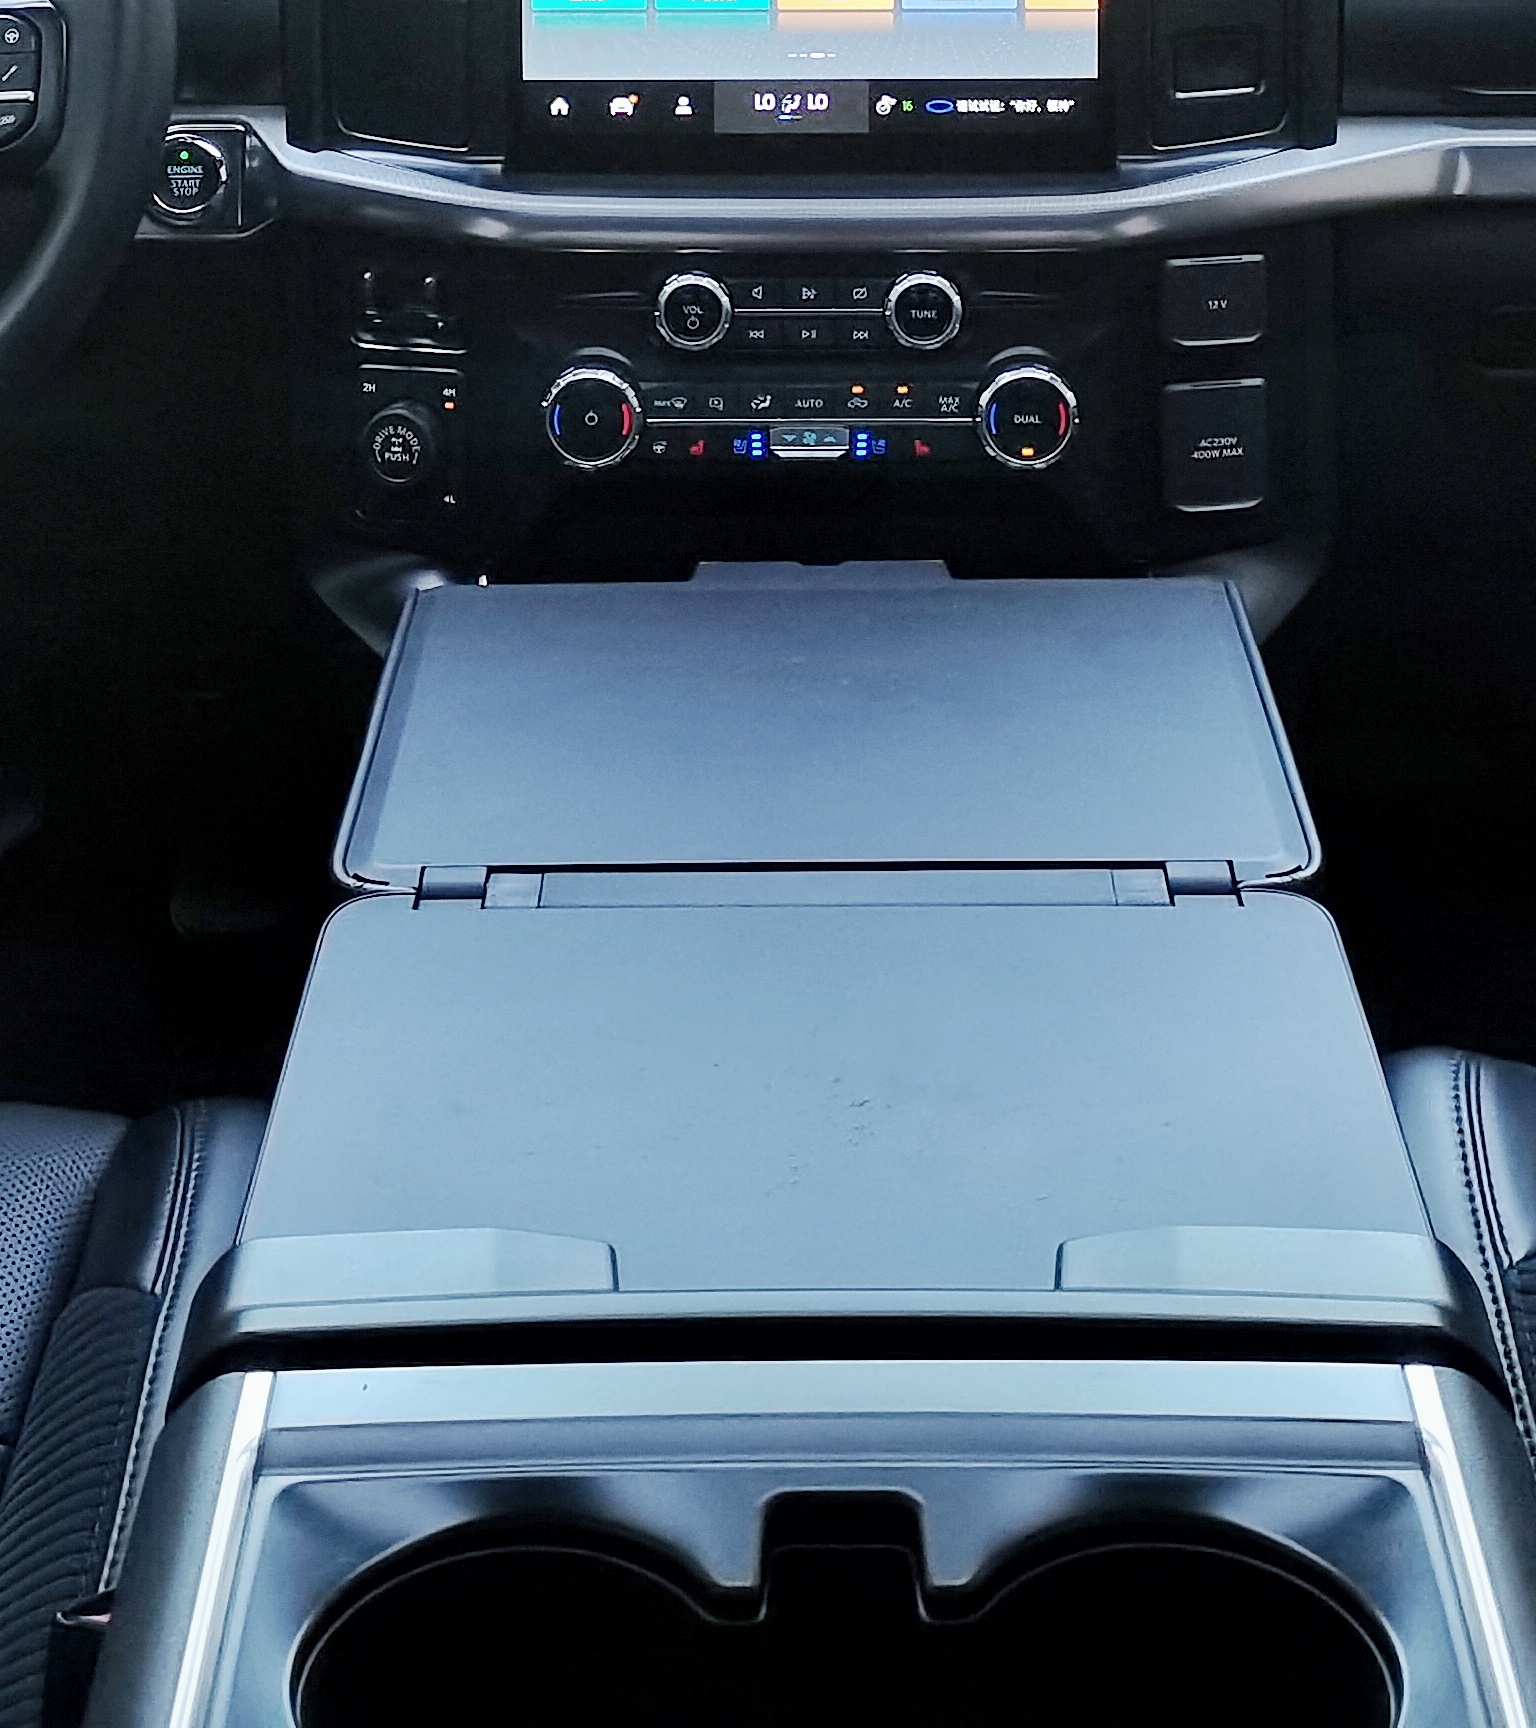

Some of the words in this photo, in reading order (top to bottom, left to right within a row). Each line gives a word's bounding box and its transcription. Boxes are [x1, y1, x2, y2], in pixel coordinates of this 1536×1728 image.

[754, 92, 776, 111] LO
[807, 92, 829, 111] LO
[167, 165, 203, 173] ENGINE
[170, 179, 201, 188] START
[173, 187, 199, 197] STOP
[682, 305, 705, 315] VOL
[909, 309, 938, 319] TUNE
[362, 383, 376, 392] 2H
[795, 399, 824, 408] AUTO
[893, 399, 913, 408] A/C
[939, 395, 960, 405] MAX
[940, 404, 960, 413] A/C
[1013, 414, 1042, 424] DUAL
[372, 425, 395, 450] DRIVE
[397, 425, 421, 453] MODE
[385, 452, 410, 462] PUSH
